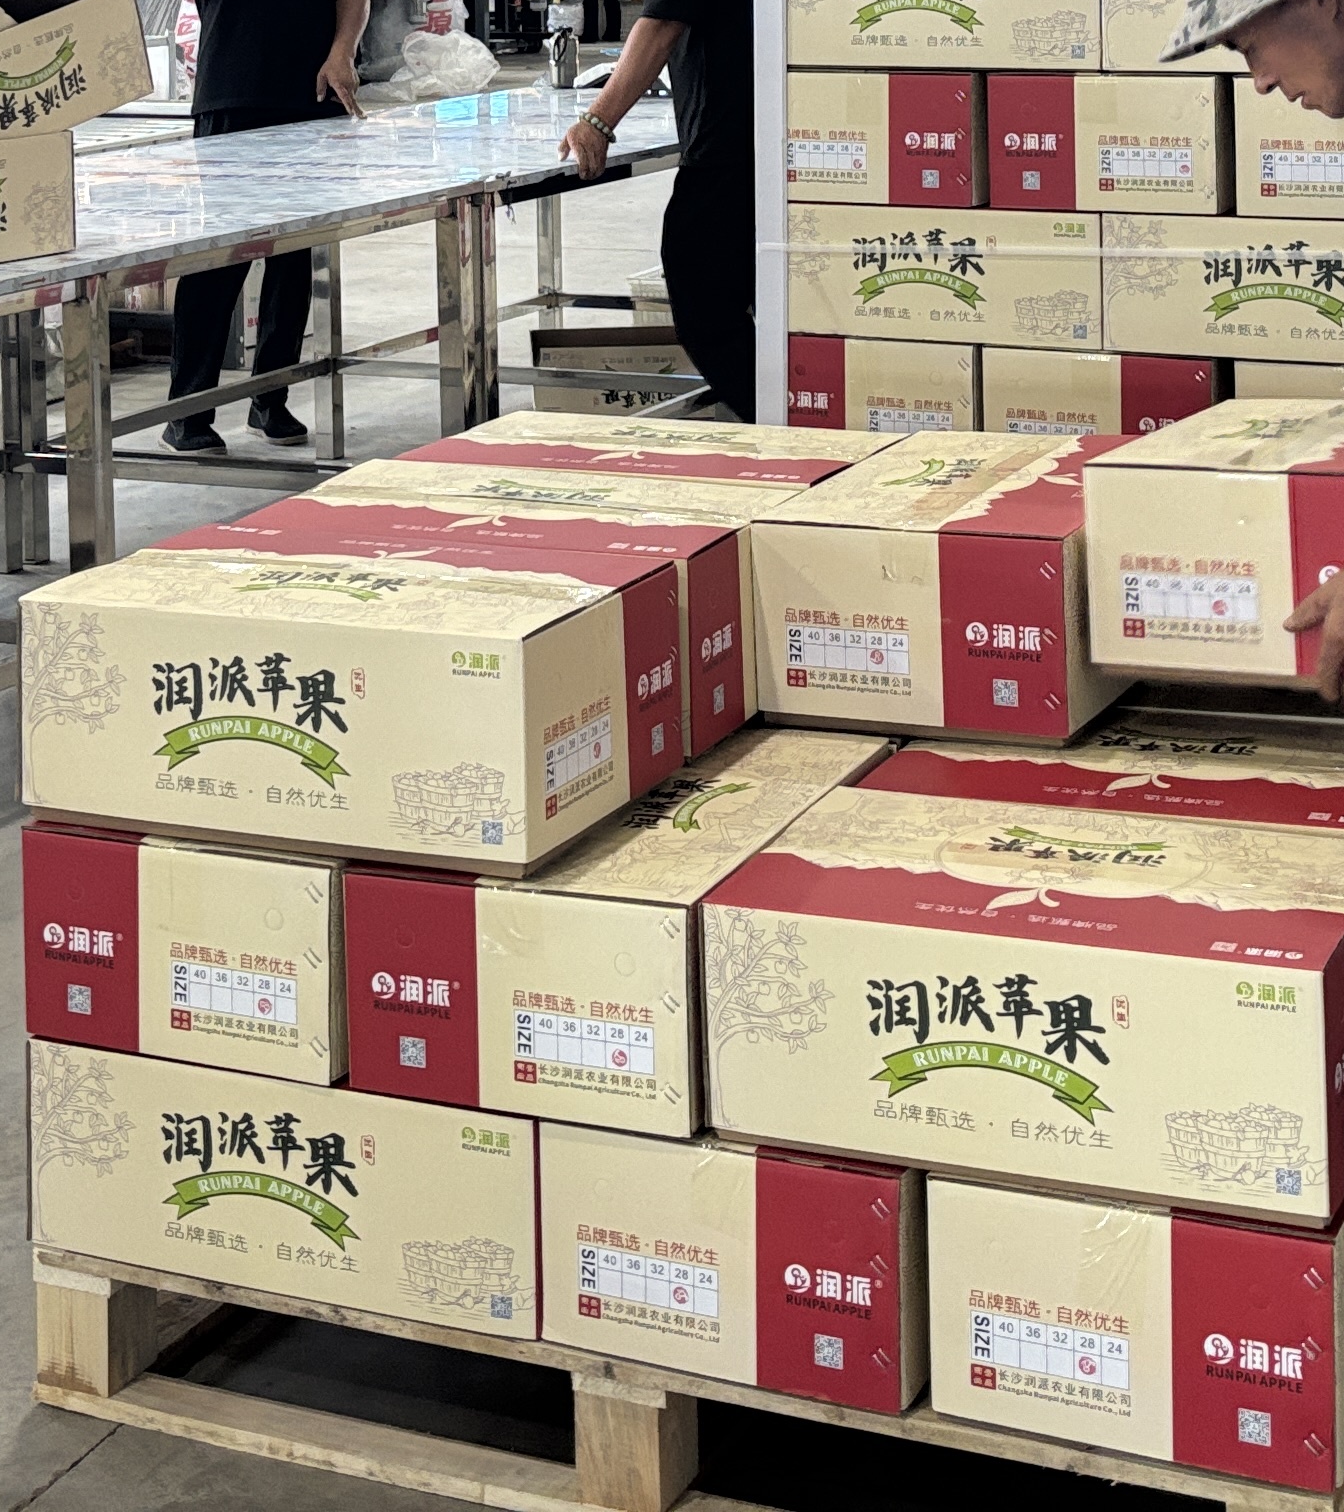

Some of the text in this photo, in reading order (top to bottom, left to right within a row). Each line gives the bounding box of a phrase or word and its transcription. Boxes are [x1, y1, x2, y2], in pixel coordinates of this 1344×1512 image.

[922, 132, 956, 151] 润派
[1022, 132, 1057, 152] 润派
[1101, 149, 1112, 175] SIZE
[1262, 153, 1274, 180] SIZE
[851, 228, 986, 277] 润派苹果
[876, 270, 964, 291] RUNPAI APPLE
[1230, 285, 1329, 307] RUNPAI APPLE
[853, 305, 987, 324] 品牌甄选·自然优生
[796, 390, 829, 410] 润派
[1124, 575, 1141, 614] SIZE
[784, 607, 910, 631] 品牌甄选·自然优生
[711, 621, 735, 657] 润派
[788, 628, 803, 665] SIZE
[967, 647, 1043, 664] RUNPAI APPLE
[992, 623, 1043, 652] 润派
[468, 652, 501, 672] 润派
[648, 658, 675, 695] 润派
[150, 651, 350, 735] 润派苹果
[187, 720, 317, 755] RUNPAI APPLE
[544, 748, 557, 792] SIZE
[153, 772, 351, 812] 品牌甄选·自然优生
[44, 949, 115, 970] RUNPAI APPLE
[67, 925, 115, 959] 润派
[169, 941, 299, 977] 品牌甄选·自然优生
[172, 963, 189, 1005] SIZE
[399, 974, 452, 1008] 润派
[1257, 982, 1298, 1005] 润派
[372, 999, 452, 1021] RUNPAI APPLE
[511, 989, 656, 1025] 品牌甄选·自然优生
[864, 972, 1112, 1066] 润派苹果
[1236, 998, 1298, 1014] RUNPAI APPLE
[516, 1012, 533, 1056] SIZE
[538, 1017, 649, 1043] 40 36 32 28 24
[911, 1043, 1071, 1089] RUNPAI APPLE
[477, 1129, 511, 1149] 润派
[872, 1098, 1115, 1151] 品牌甄选·自然优生
[160, 1110, 360, 1199] 润派苹果
[461, 1142, 512, 1157] RUNPAI APPLE
[198, 1175, 327, 1218] RUNPAI APPLE
[163, 1221, 362, 1275] 品牌甄选·自然优生
[576, 1223, 721, 1267] 品牌甄选·自然优生
[580, 1247, 597, 1290] SIZE
[602, 1252, 714, 1285] 40 36 32 28 24
[814, 1267, 873, 1308] 润派
[601, 1299, 721, 1335] 长沙润派农业有限公司
[785, 1292, 873, 1321] RUNPAI APPLE
[967, 1288, 1131, 1336] 品牌甄选·自然优生
[973, 1315, 991, 1360] SIZE
[997, 1321, 1124, 1357] 40 36 32 28 24
[1239, 1337, 1305, 1382] 润派
[997, 1369, 1133, 1409] 长沙润派农业有限公司
[997, 1383, 1033, 1400] Changsha
[1204, 1363, 1305, 1396] RUNPAI APPLE
